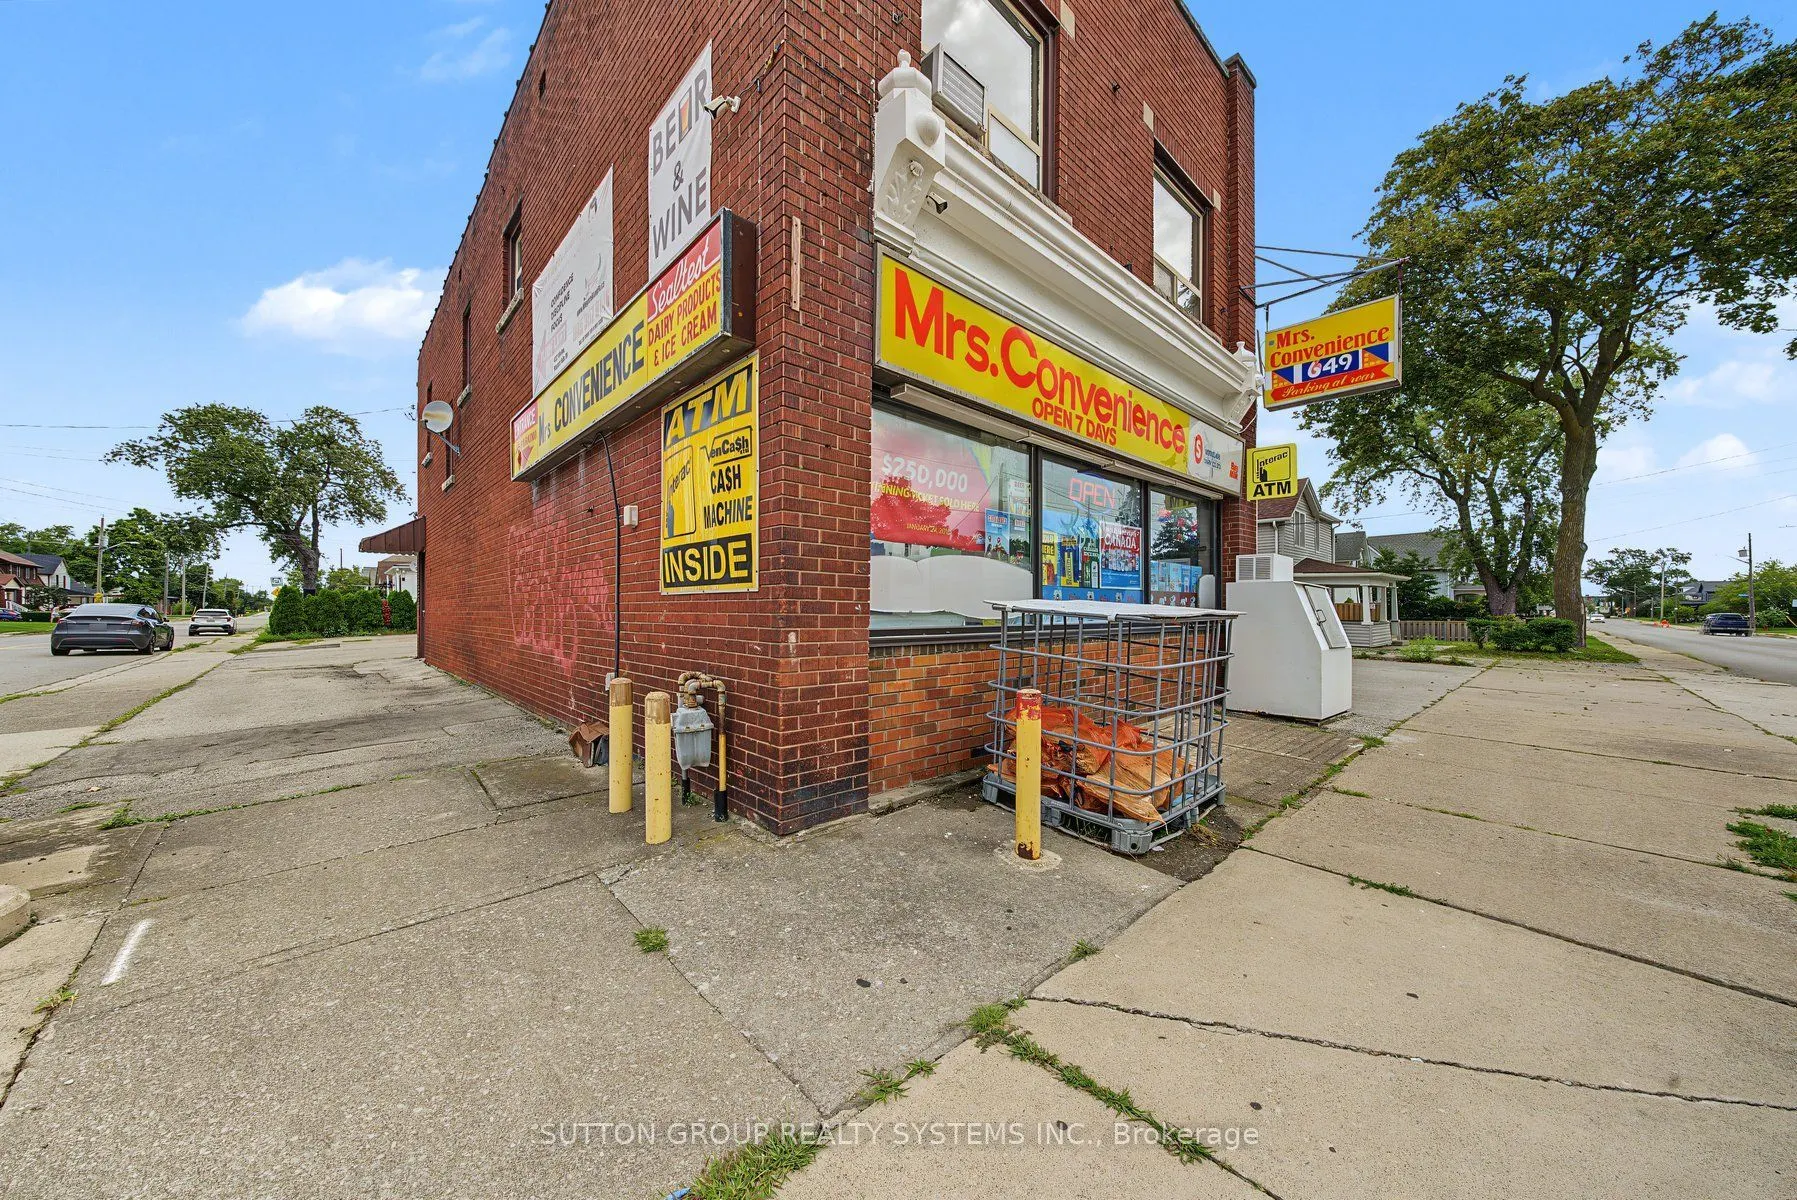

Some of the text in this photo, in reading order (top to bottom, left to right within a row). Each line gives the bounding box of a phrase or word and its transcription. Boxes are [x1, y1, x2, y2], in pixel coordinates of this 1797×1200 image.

[673, 160, 684, 191] &
[652, 166, 707, 260] WINE
[650, 236, 720, 318] Sealtest
[648, 309, 675, 347] DAIRY
[676, 272, 720, 321] PRODUCTS
[654, 301, 717, 367] & ICE CREAM
[1270, 326, 1390, 368] Convenience
[1276, 328, 1315, 349] Mrs.
[554, 320, 645, 433] CONVENIENCE
[894, 267, 1186, 455] Mrs. Convenience
[1307, 353, 1353, 378] 649
[1282, 382, 1331, 398] Parking
[1332, 375, 1348, 387] at
[666, 371, 748, 449] ATM
[1032, 397, 1117, 446] OPEN 7 DAYS
[881, 453, 968, 493] $250,000
[1256, 451, 1288, 473] Interac
[1068, 477, 1116, 508] OPEN
[1253, 481, 1291, 497] ATM
[704, 495, 753, 529] MACHINE
[664, 540, 749, 583] INSIDE
